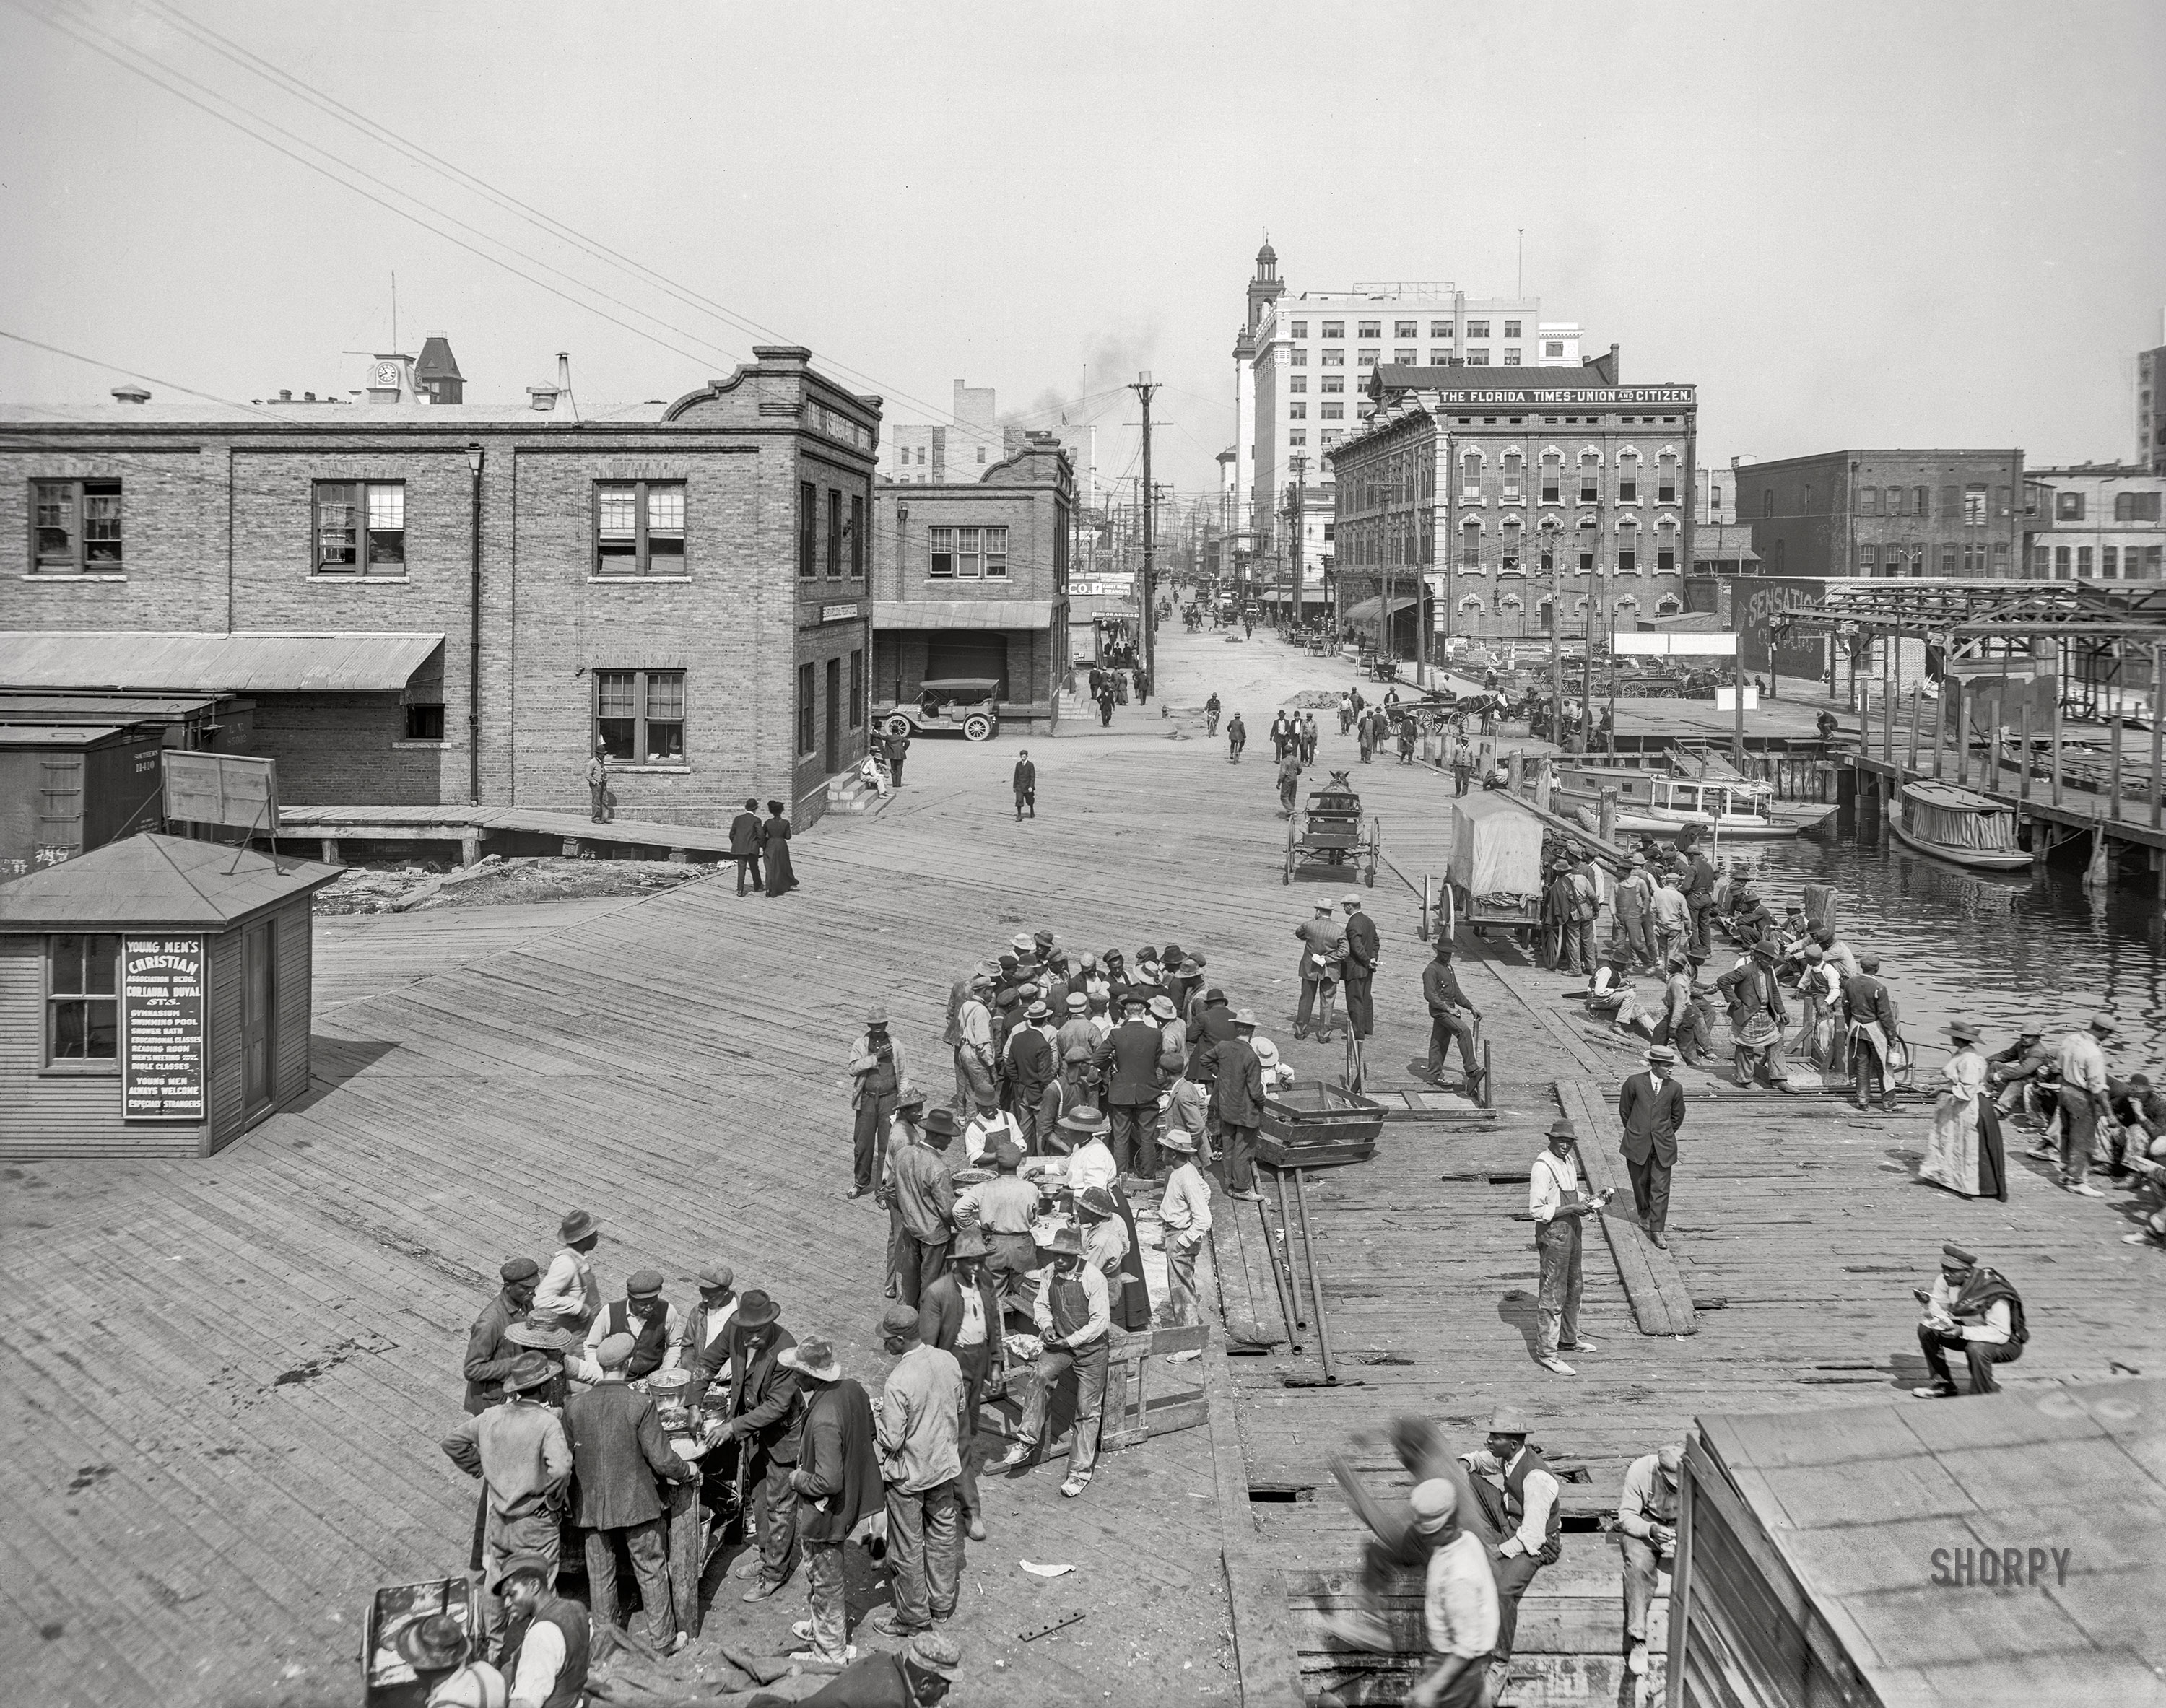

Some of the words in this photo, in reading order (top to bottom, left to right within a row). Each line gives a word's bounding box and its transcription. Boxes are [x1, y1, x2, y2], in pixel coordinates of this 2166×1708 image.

[1441, 391, 1464, 402] THE
[1470, 391, 1526, 402] FLORIDA
[1534, 391, 1616, 401] TIMES-UNION
[1636, 391, 1692, 401] CITIZEN.
[1069, 583, 1092, 594] CO.
[135, 760, 155, 773] 11410
[126, 941, 160, 953] YOUNG
[164, 940, 199, 953] MEN'S
[128, 955, 199, 975] CHRISTIAN
[173, 986, 201, 997] DUVAL
[128, 1086, 158, 1095] ALWAYS
[160, 1086, 199, 1095] WELCOME
[163, 1099, 201, 1108] STRANGERS
